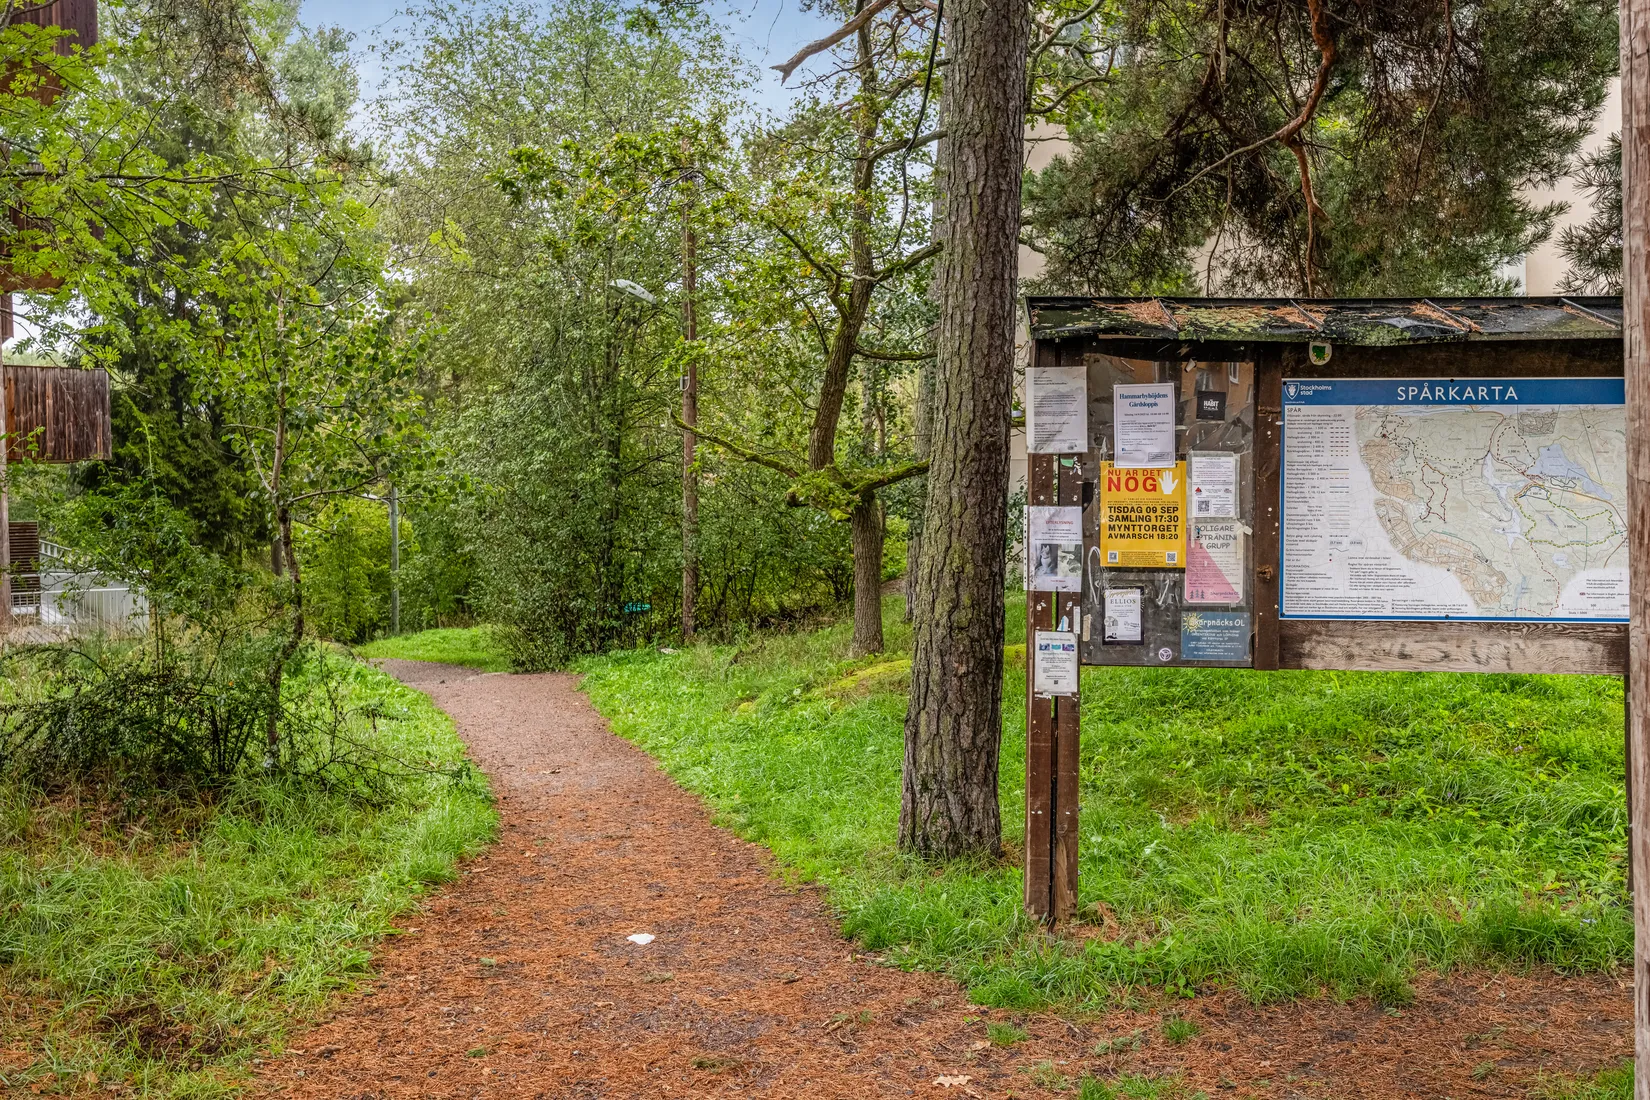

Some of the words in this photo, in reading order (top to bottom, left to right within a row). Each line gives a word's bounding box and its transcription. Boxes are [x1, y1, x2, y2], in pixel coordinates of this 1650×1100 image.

[1397, 382, 1518, 400] SPÅRKARTA
[1108, 477, 1157, 492] NOG
[1192, 618, 1233, 627] karpnäcks
